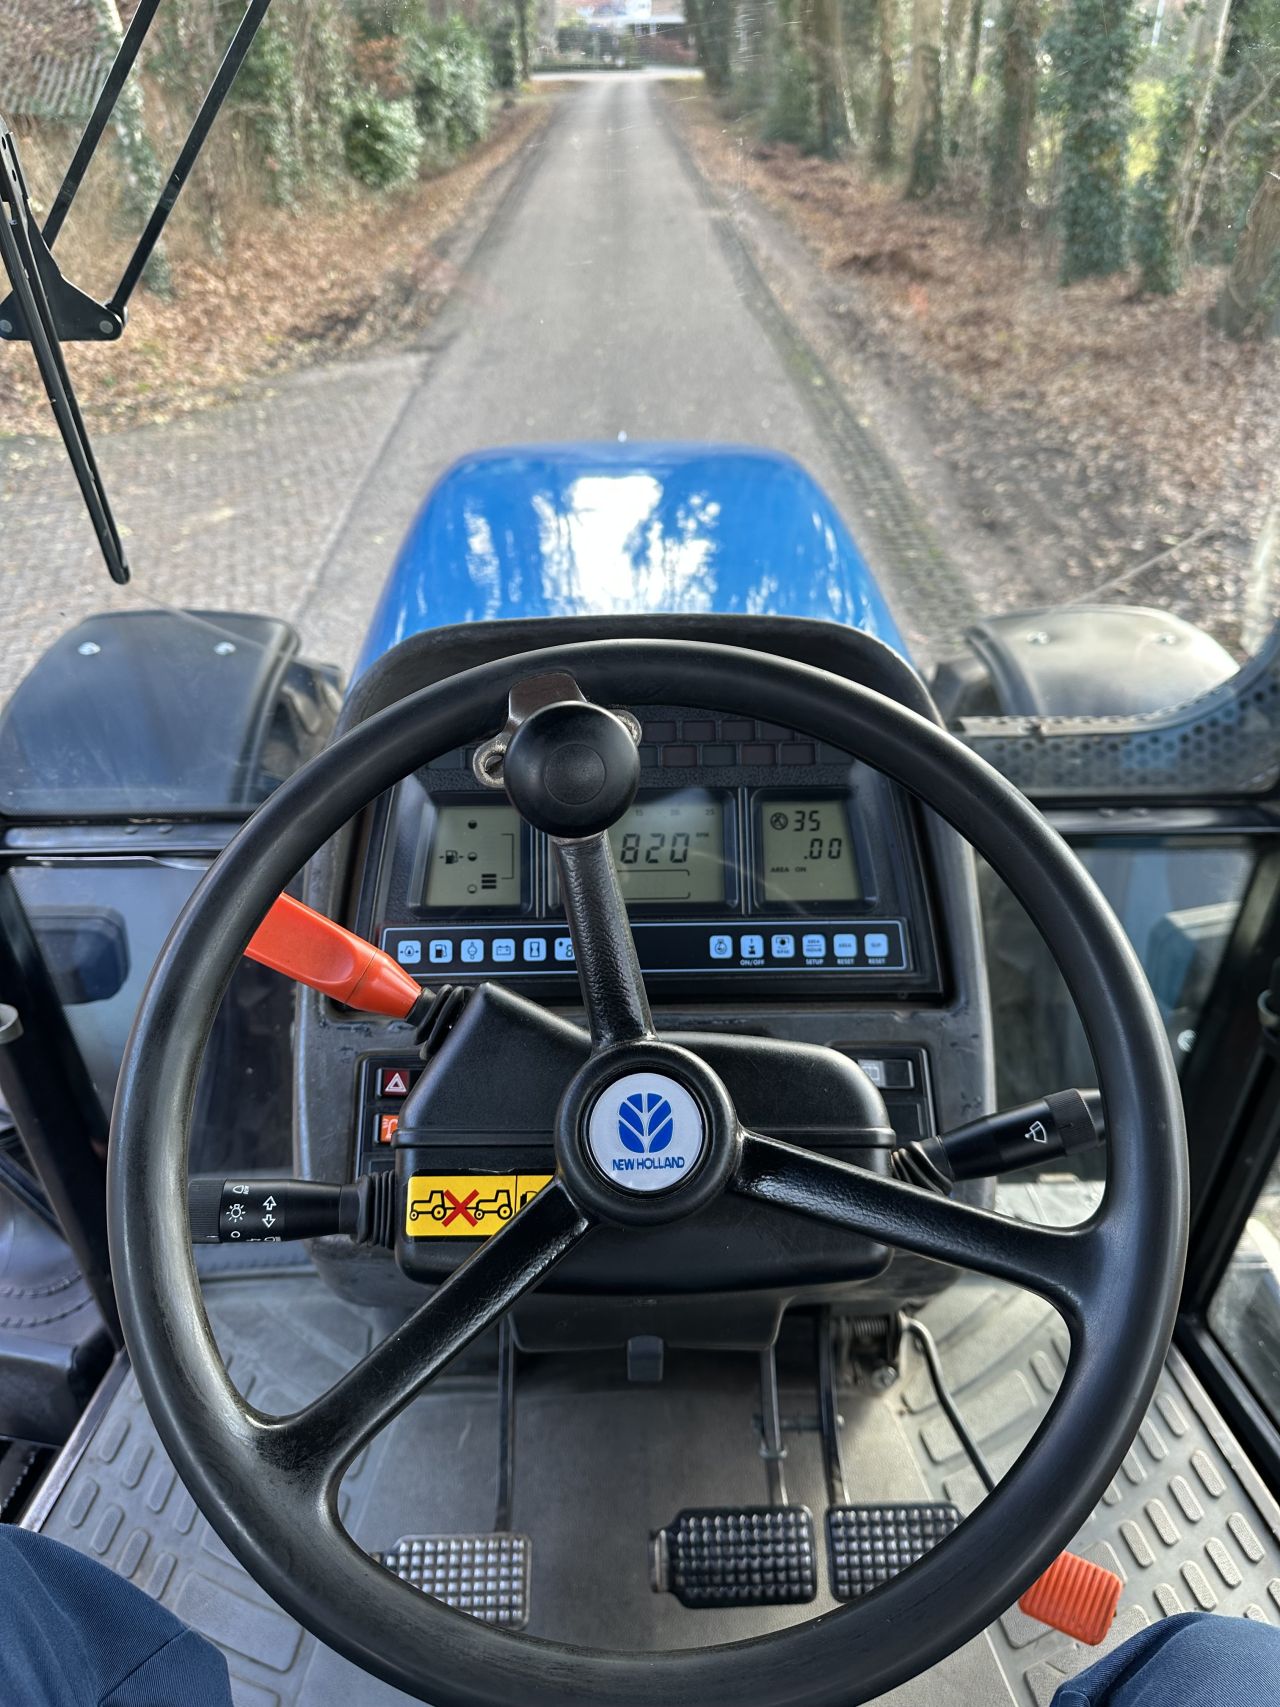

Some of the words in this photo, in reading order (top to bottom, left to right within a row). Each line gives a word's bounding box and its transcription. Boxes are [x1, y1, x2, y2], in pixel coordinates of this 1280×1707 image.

[793, 810, 821, 832] 35
[620, 832, 690, 864] 820
[804, 838, 842, 860] .00
[612, 1158, 635, 1171] NEW
[636, 1156, 685, 1170] HOLLAND
